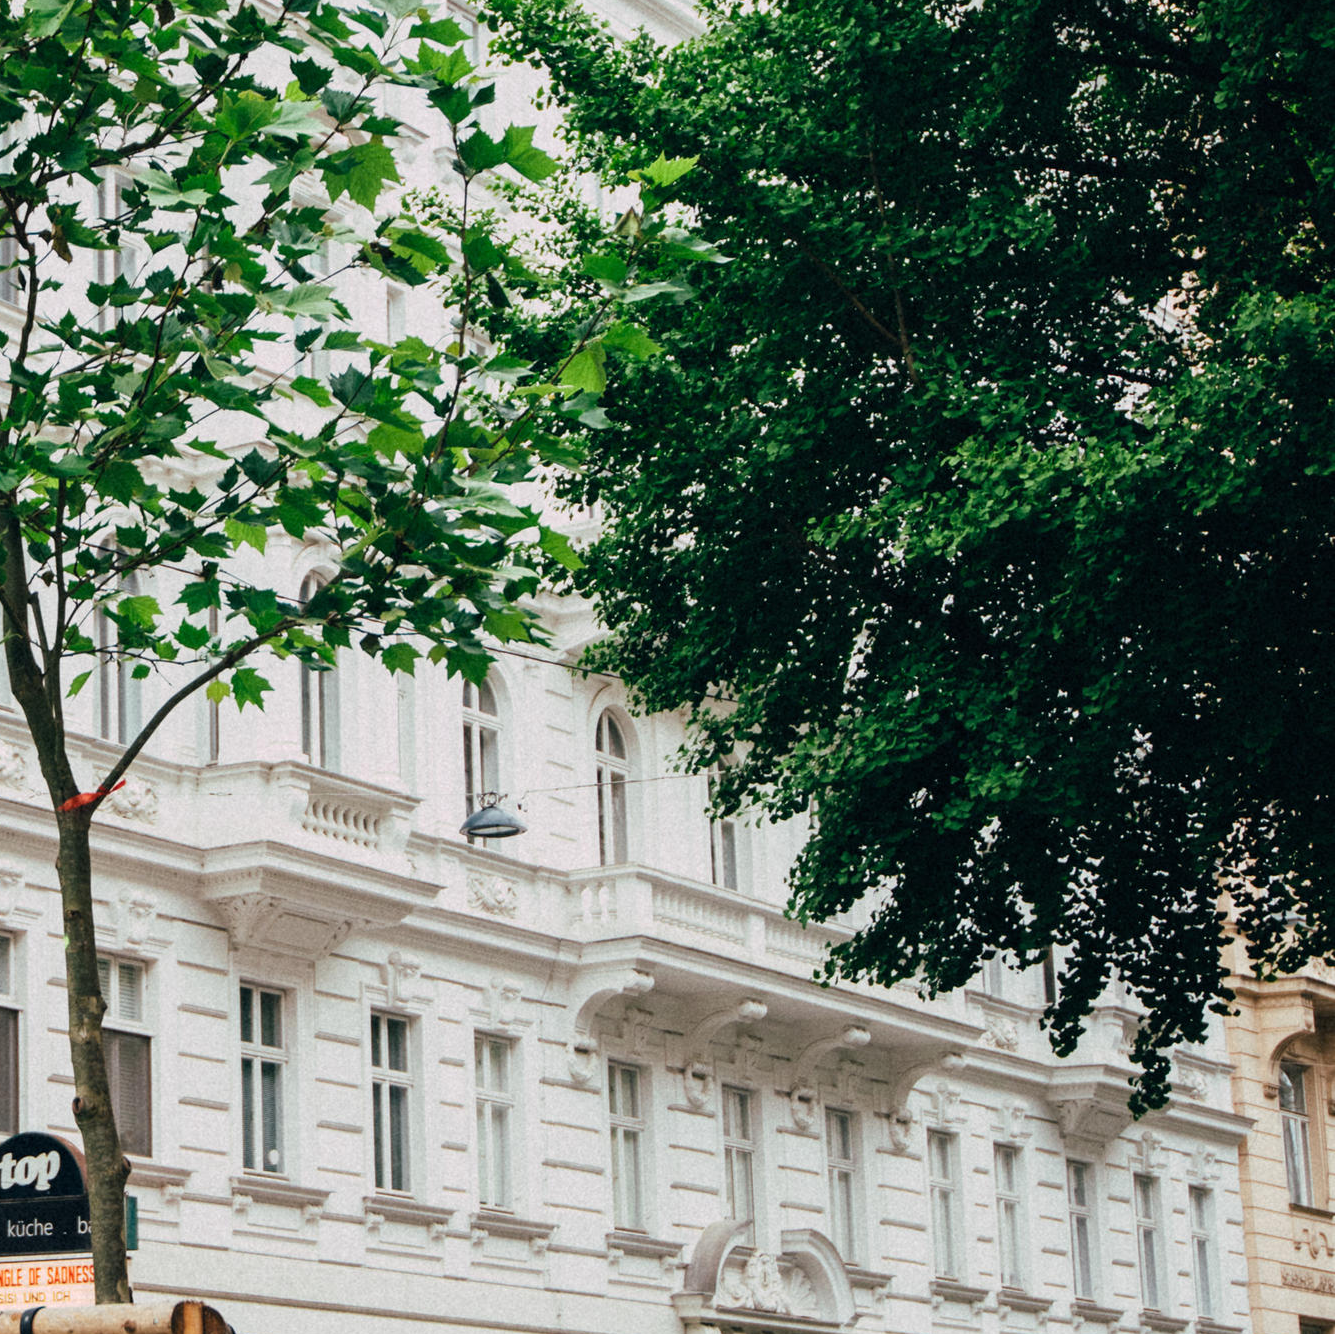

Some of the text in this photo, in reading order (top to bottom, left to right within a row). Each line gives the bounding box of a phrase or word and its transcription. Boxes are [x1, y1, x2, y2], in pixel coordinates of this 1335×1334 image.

[7, 1218, 54, 1238] küche
[29, 1267, 42, 1285] OF
[47, 1264, 95, 1286] SADNESS
[23, 1291, 46, 1304] UND
[53, 1289, 71, 1302] ICH
